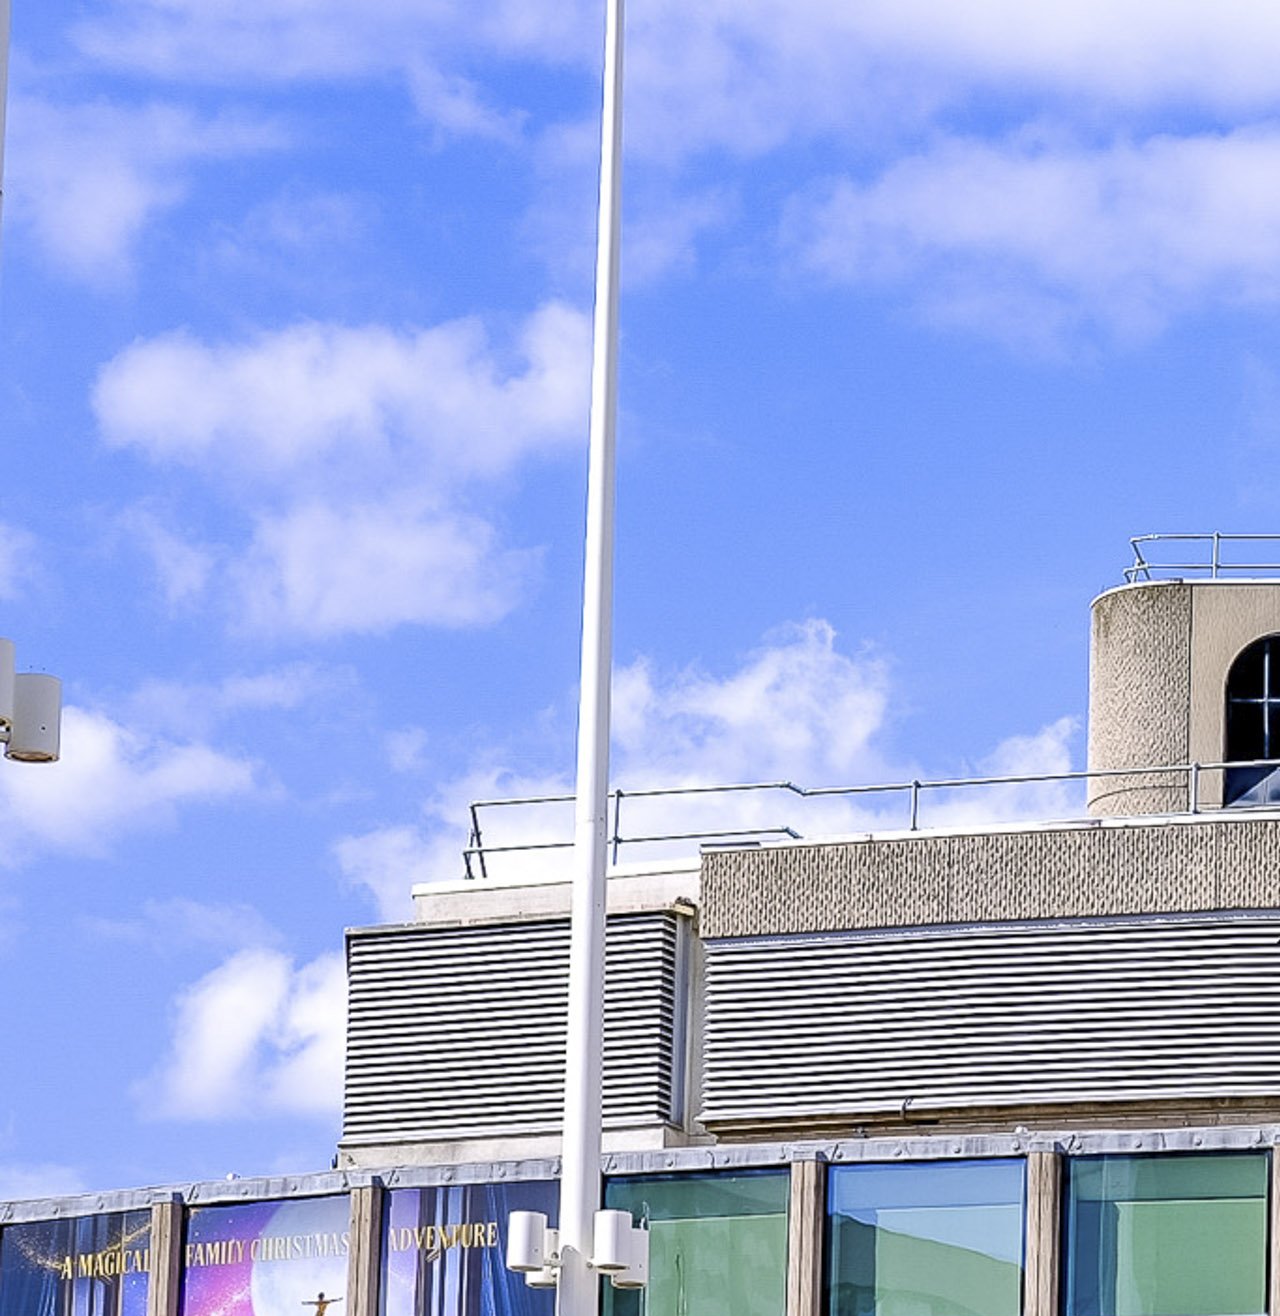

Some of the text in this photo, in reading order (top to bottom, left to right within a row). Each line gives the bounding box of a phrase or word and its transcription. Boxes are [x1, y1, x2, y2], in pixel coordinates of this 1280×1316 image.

[60, 1222, 498, 1280] A MAGICAL FAMILY CHRISTMAS ADVENTURE
